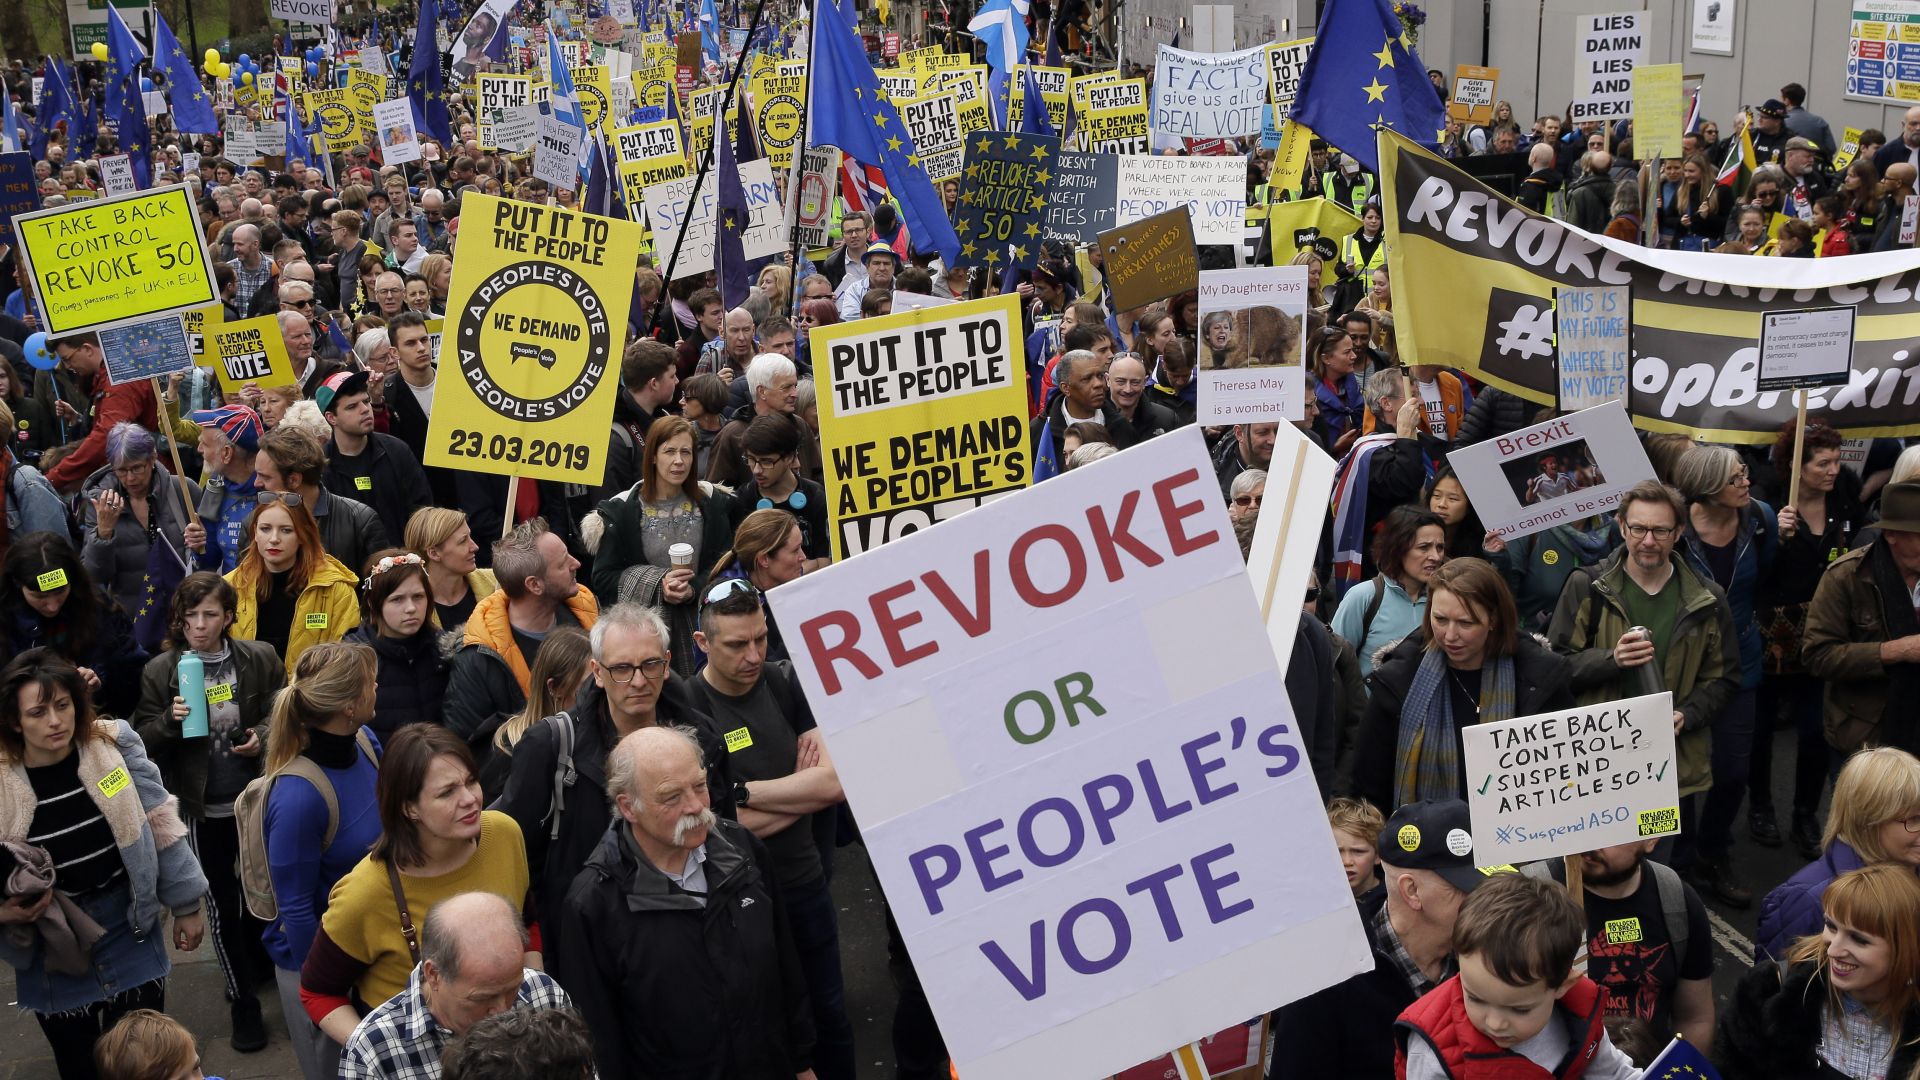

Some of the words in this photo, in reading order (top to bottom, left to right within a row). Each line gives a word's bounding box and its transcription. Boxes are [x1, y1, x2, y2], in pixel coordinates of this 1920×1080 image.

[271, 0, 329, 17] REVOKE
[1885, 14, 1909, 22] SAFETY
[1593, 15, 1634, 32] LIES
[1586, 36, 1641, 52] DAMN
[1161, 51, 1185, 64] now
[1271, 46, 1300, 67] PUT
[1592, 59, 1633, 74] LIES
[1168, 62, 1264, 90] FACTS
[1274, 67, 1290, 82] TO
[482, 80, 508, 94] PUT
[514, 81, 526, 94] IT
[1090, 89, 1111, 100] PUT
[1114, 87, 1123, 97] IT
[1126, 84, 1140, 96] TO
[1462, 85, 1486, 93] PEOPLE
[1592, 78, 1630, 94] AND
[482, 94, 497, 107] TO
[502, 95, 526, 108] THE
[1091, 100, 1106, 110] THE
[1110, 96, 1140, 106] PEOPLE
[1164, 90, 1197, 106] give
[1204, 95, 1222, 106] us
[1230, 89, 1248, 106] all
[1456, 96, 1474, 104] FINAL
[906, 102, 934, 122] PUT
[938, 96, 952, 113] IT
[1574, 100, 1634, 118] BREXI
[909, 121, 926, 137] TO
[929, 112, 956, 129] THE
[1090, 118, 1105, 129] WE
[1108, 113, 1146, 128] DEMAND
[1159, 108, 1206, 136] REAL
[1213, 105, 1261, 136] VOTE
[620, 132, 642, 150] PUT
[646, 130, 657, 144] IT
[661, 128, 674, 143] TO
[912, 127, 958, 149] PEOPLE
[1092, 130, 1098, 140] A
[1100, 124, 1147, 139] PEOPLE'S
[542, 136, 570, 155] THIS
[622, 147, 636, 162] THE
[637, 141, 677, 159] PEOPLE
[102, 158, 129, 168] PREVENT
[803, 156, 828, 174] STOP
[1058, 156, 1096, 170] DOESN'T
[1122, 158, 1137, 169] WE
[1142, 160, 1174, 170] VOTED
[1176, 160, 1186, 168] TO
[1190, 160, 1212, 169] BOARD
[108, 178, 123, 186] STAY
[624, 172, 640, 186] WE
[642, 164, 686, 184] DEMAND
[978, 159, 1037, 190] REVOKE
[1059, 174, 1097, 188] BRITISH
[1125, 173, 1186, 184] PARLIAMENT
[1218, 174, 1247, 184] DECIDE
[124, 182, 134, 190] EU
[1128, 188, 1160, 196] WHERE
[1168, 188, 1195, 197] WE'RE
[1200, 188, 1226, 197] GOING
[972, 186, 1034, 214] ARTICLE
[1206, 200, 1245, 218] VOTE
[39, 214, 98, 240] TAKE
[114, 200, 176, 225] BACK
[495, 201, 544, 233] PUT
[550, 211, 574, 239] IT
[582, 216, 608, 245] TO
[978, 212, 1015, 242] 50
[1200, 220, 1240, 234] HOME
[56, 226, 159, 260] CONTROL
[494, 228, 530, 252] THE
[534, 235, 606, 266] PEOPLE
[45, 252, 142, 296] REVOKE
[156, 241, 194, 270] 50
[52, 298, 83, 315] Grumpy
[124, 286, 137, 298] for
[144, 280, 166, 294] UK
[166, 278, 175, 286] in
[178, 271, 200, 286] EU
[469, 305, 485, 321] A
[479, 265, 572, 304] PEOPLE'S
[574, 282, 606, 336] VOTE
[1200, 285, 1219, 298] My
[1221, 282, 1274, 298] Daughter
[1278, 282, 1301, 294] says
[1560, 292, 1596, 314] THIS
[1601, 292, 1617, 312] IS
[215, 334, 226, 345] WE
[228, 328, 261, 344] DEMAND
[494, 312, 514, 332] WE
[520, 317, 581, 342] DEMAND
[1560, 319, 1580, 339] MY
[1582, 316, 1625, 338] FUTURE
[220, 348, 225, 356] A
[224, 340, 264, 355] PEOPLE'S
[514, 346, 538, 356] People's
[541, 354, 554, 362] Vote
[831, 336, 902, 382] PUT
[914, 327, 947, 367] IT
[959, 318, 1002, 358] TO
[223, 352, 271, 380] VOTE
[1562, 350, 1606, 374] WHERE
[1611, 350, 1624, 372] IS
[460, 349, 476, 366] A
[468, 367, 556, 418] PEOPLE'S
[558, 362, 602, 410] VOTE
[835, 376, 890, 411] THE
[899, 356, 1006, 400] PEOPLE
[1213, 380, 1257, 392] Theresa
[1260, 378, 1284, 392] May
[1562, 378, 1582, 397] MY
[1586, 374, 1627, 397] VOTE?
[1214, 404, 1222, 415] is
[1226, 406, 1232, 414] a
[1235, 402, 1285, 414] wombat!
[832, 441, 879, 481] WE
[889, 415, 1022, 471] DEMAND
[1496, 420, 1574, 456] Brexit
[448, 428, 590, 471] 23.03.2019
[838, 483, 858, 517] A
[866, 451, 1025, 510] PEOPLE'S
[1519, 506, 1568, 530] cannot
[1575, 501, 1595, 513] be
[799, 467, 1220, 696] REVOKE
[1003, 671, 1107, 745] OR
[1490, 719, 1558, 750] TAKE
[1567, 709, 1633, 737] BACK
[1499, 728, 1642, 770] CONTROL?
[1498, 757, 1610, 792] SUSPEND
[1498, 778, 1603, 814] ARTICLE
[908, 716, 1300, 916] PEOPLE's
[1640, 808, 1675, 818] BOLLOCKS
[1652, 814, 1674, 822] BREXIT
[1641, 820, 1676, 830] BOLLOCKS
[1652, 826, 1675, 834] TRUMP
[978, 842, 1255, 1002] VOTE
